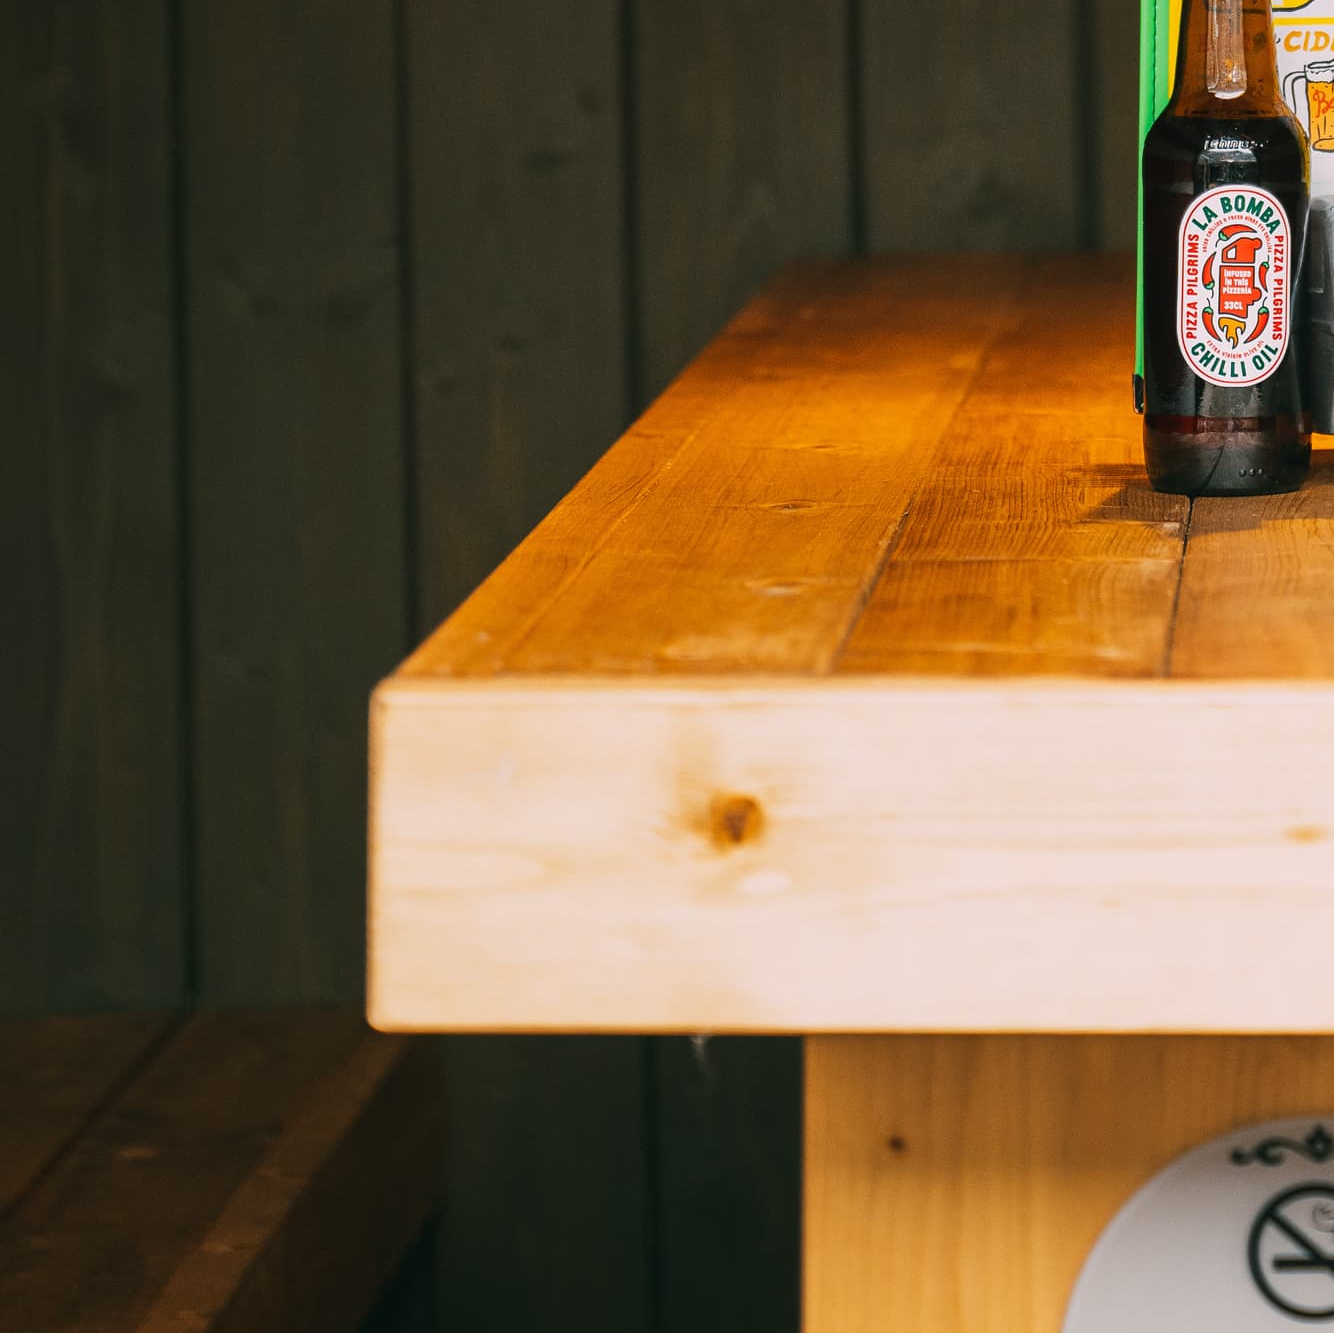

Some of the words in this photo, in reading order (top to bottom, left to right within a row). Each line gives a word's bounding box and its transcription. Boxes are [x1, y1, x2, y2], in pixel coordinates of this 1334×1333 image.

[1192, 206, 1218, 231] LA
[1220, 195, 1281, 234] BOMBA
[1186, 233, 1200, 296] PILGRIMS
[1273, 235, 1285, 273] PIZZA
[1222, 285, 1253, 295] PIZZERIA
[1223, 268, 1252, 278] INFUSED
[1224, 277, 1233, 286] IN
[1234, 277, 1249, 286] THIS
[1186, 301, 1198, 340] PIZZA
[1224, 300, 1243, 310] 33CL
[1272, 278, 1285, 341] PILGRIMS
[1191, 342, 1247, 378] CHILLI
[1251, 344, 1279, 371] OIL
